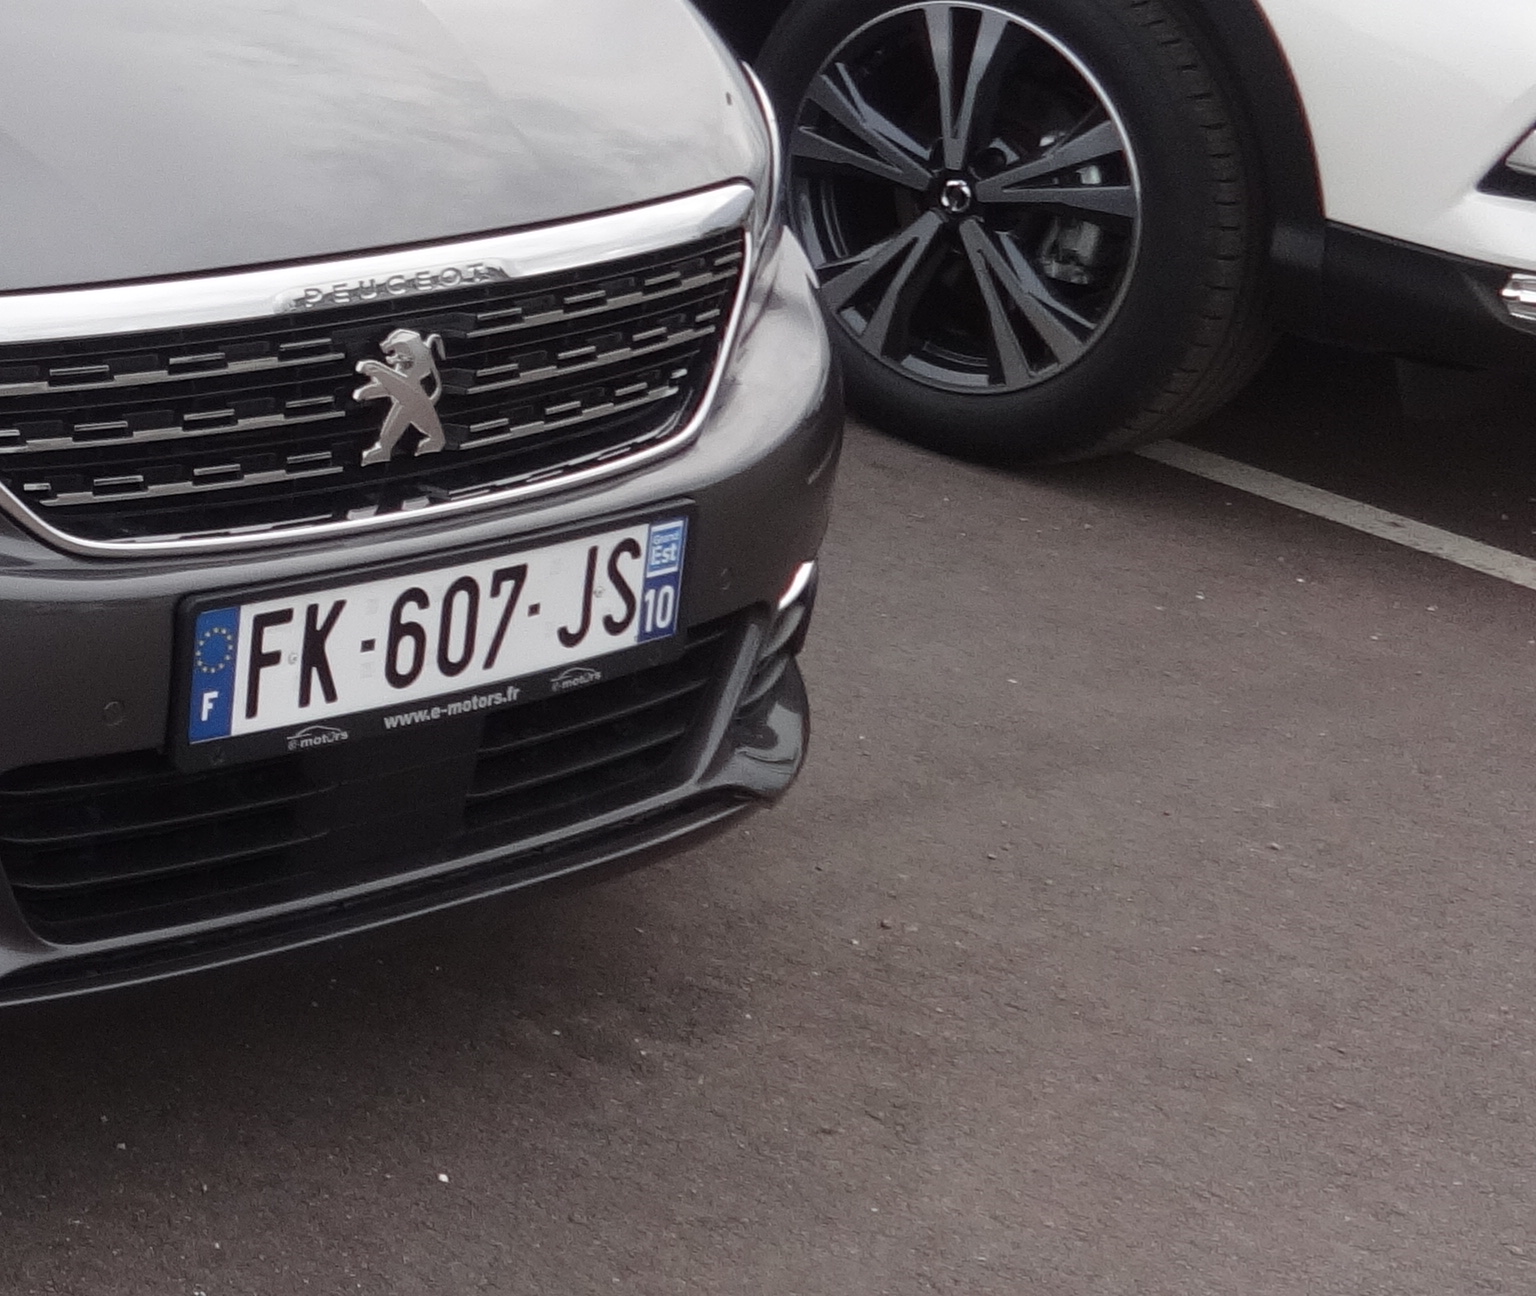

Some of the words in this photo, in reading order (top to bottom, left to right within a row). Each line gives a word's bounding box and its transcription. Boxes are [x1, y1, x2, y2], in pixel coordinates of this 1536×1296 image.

[304, 262, 485, 308] PEUGEOT
[651, 543, 678, 565] Est
[244, 537, 642, 719] FK-607-JS
[644, 585, 675, 633] 10
[200, 690, 218, 723] F
[384, 686, 521, 729] www.e-motors.fr
